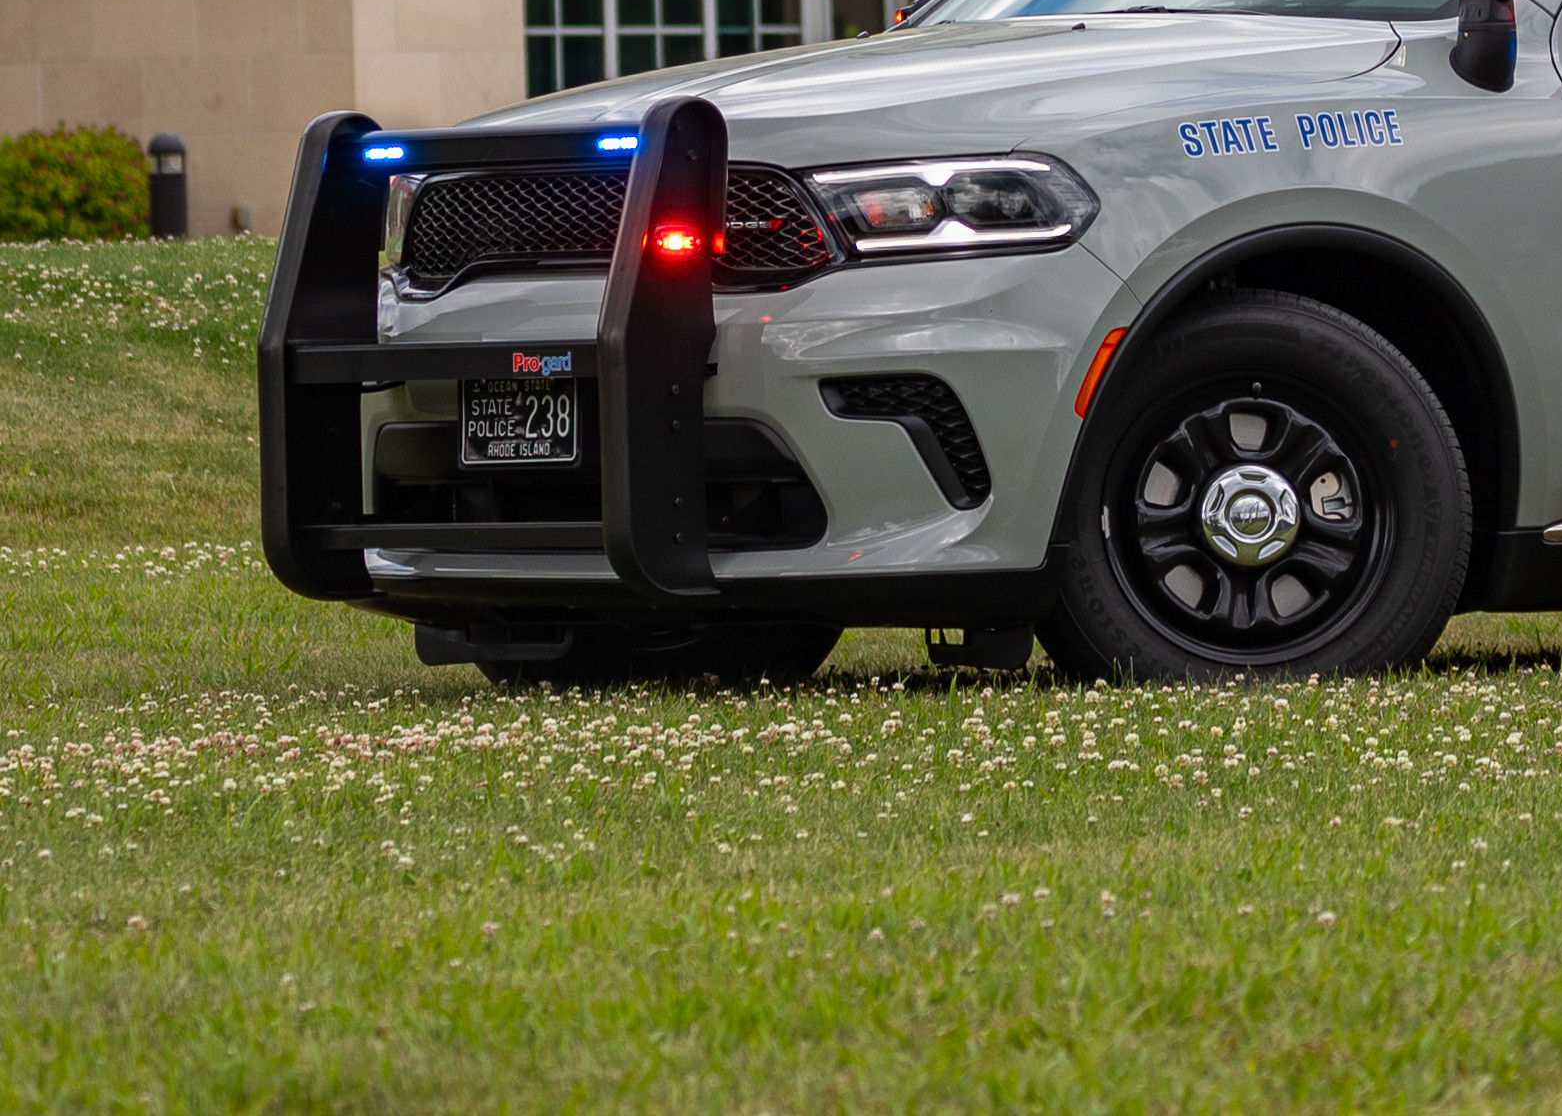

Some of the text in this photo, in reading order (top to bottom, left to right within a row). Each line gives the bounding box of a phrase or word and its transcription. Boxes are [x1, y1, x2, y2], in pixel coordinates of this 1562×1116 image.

[1178, 109, 1403, 158] STATE POLICE
[488, 379, 551, 393] OCEAN STATE
[471, 397, 513, 416] STATE
[525, 394, 570, 438] 238
[468, 420, 516, 438] POLICE
[488, 442, 550, 457] RHODE ISLAND
